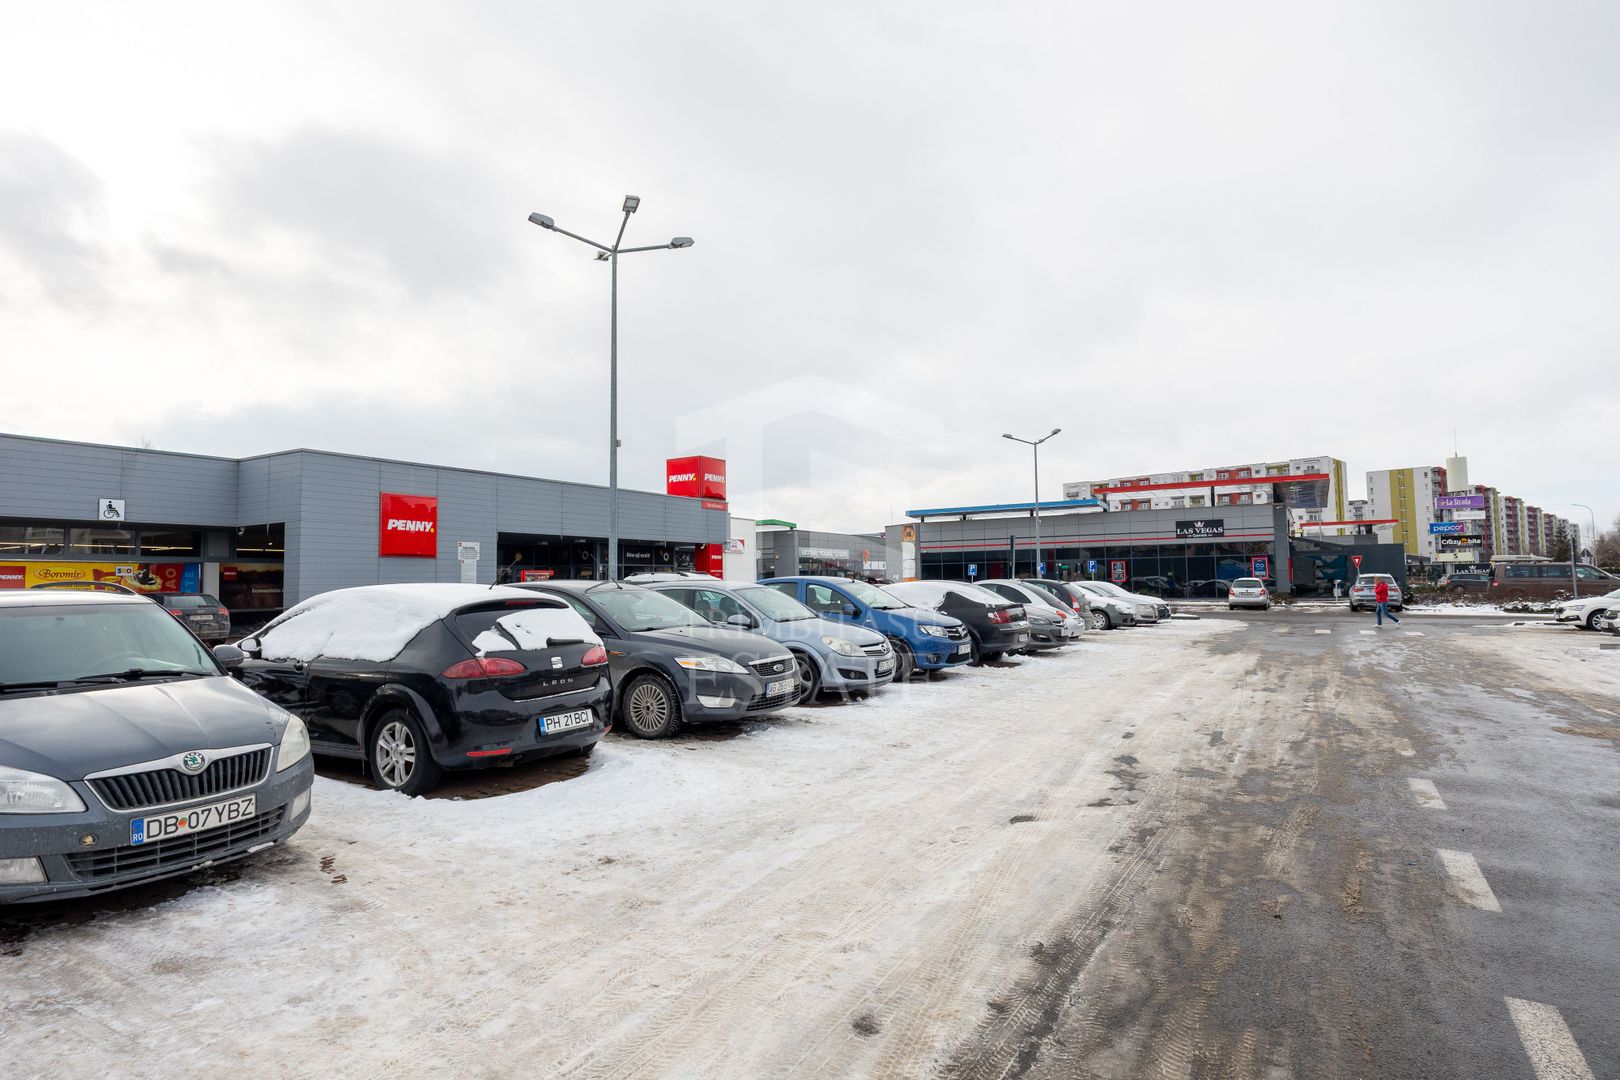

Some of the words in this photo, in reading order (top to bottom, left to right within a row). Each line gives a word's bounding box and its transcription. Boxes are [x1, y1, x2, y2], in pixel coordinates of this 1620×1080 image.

[669, 473, 696, 483] PENNY.
[1453, 498, 1471, 506] Strada
[387, 518, 435, 533] PENNY.
[1441, 538, 1462, 546] Crazy
[39, 569, 81, 578] Boromir
[543, 678, 573, 686] LEON
[546, 717, 561, 731] PH
[146, 815, 180, 839] DB
[132, 832, 143, 842] RO
